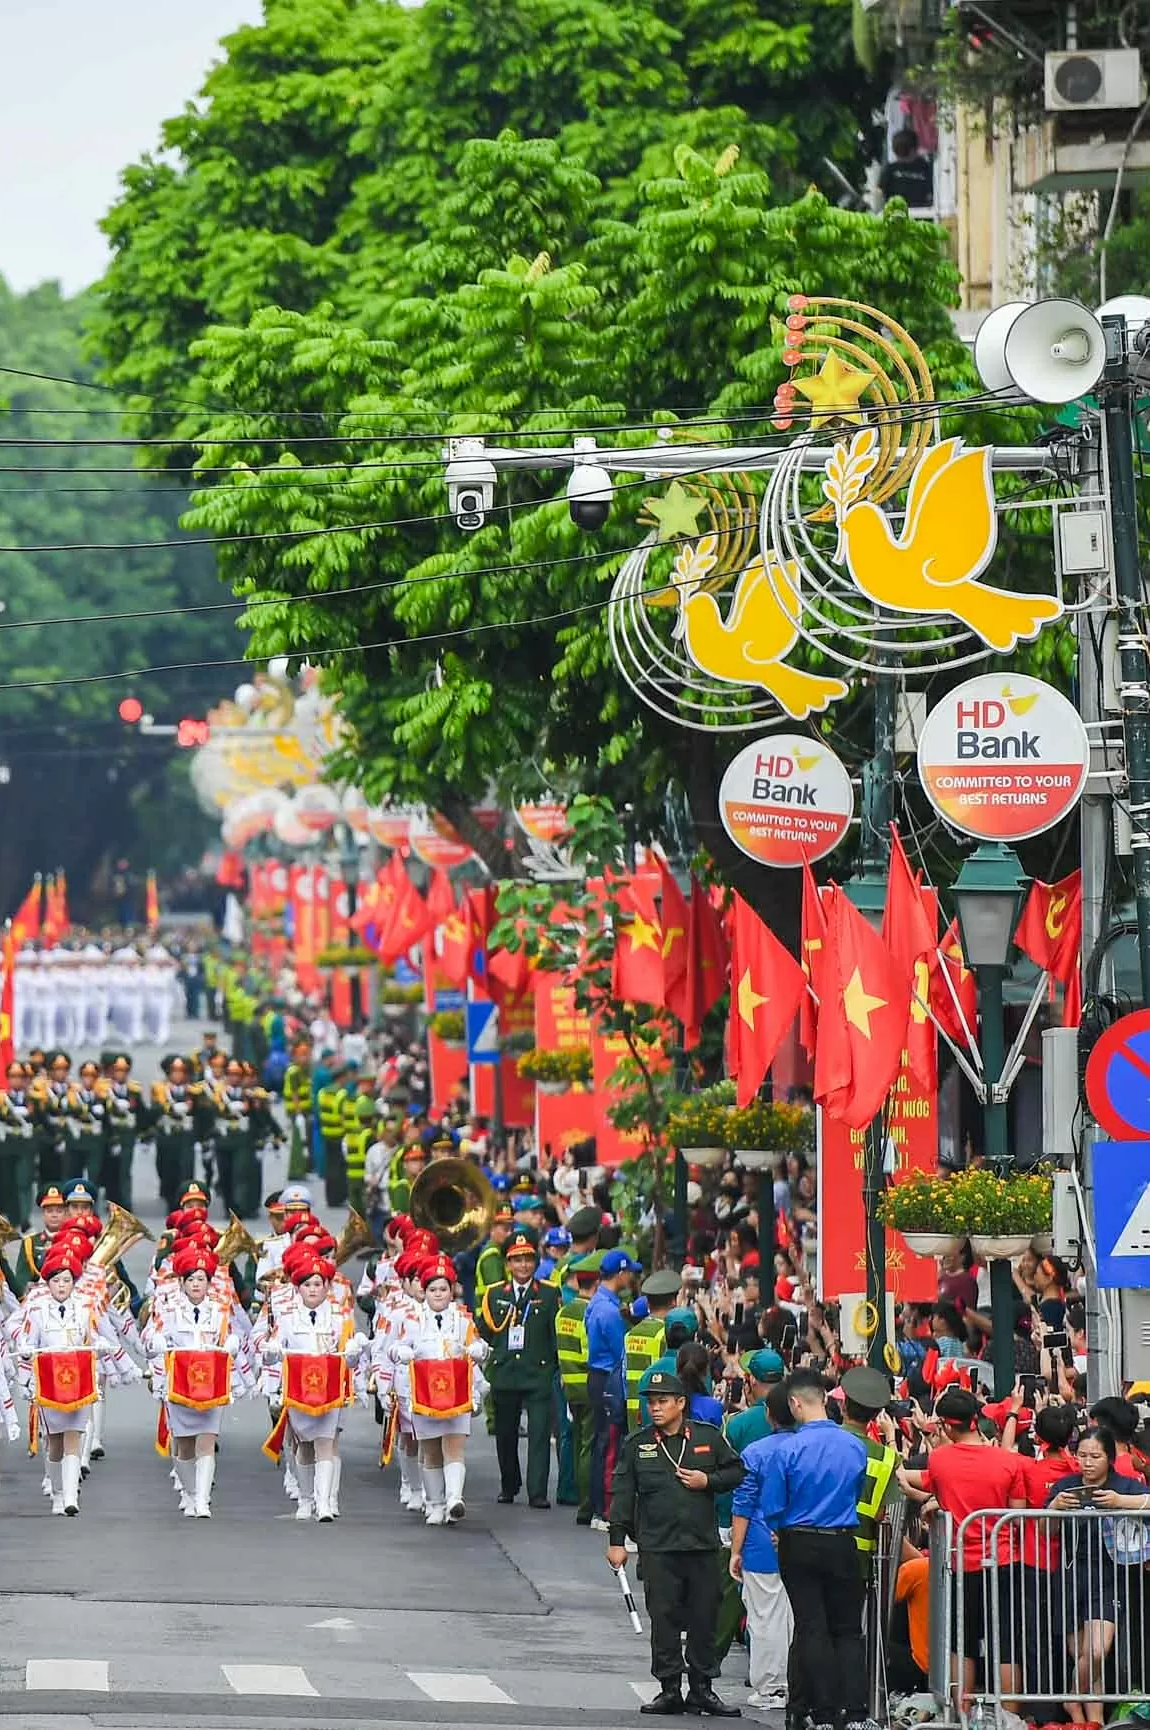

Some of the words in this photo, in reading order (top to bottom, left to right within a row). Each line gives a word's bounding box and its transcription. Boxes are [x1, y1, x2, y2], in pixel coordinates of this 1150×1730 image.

[956, 700, 1006, 729] HD
[956, 730, 1041, 759] Bank
[754, 753, 794, 778] HD
[752, 778, 818, 806] Bank
[935, 776, 1012, 789] COMMITTED
[1014, 776, 1032, 787] TO
[1035, 775, 1072, 787] YOUR
[958, 793, 989, 805] BEST
[991, 792, 1047, 805] RETURNS
[732, 810, 792, 826] COMMITTED
[794, 818, 808, 828] TO
[810, 820, 838, 832] YOUR
[749, 826, 773, 838] BEST
[774, 828, 818, 843] RETURNS
[903, 1096, 930, 1119] NƯỚC
